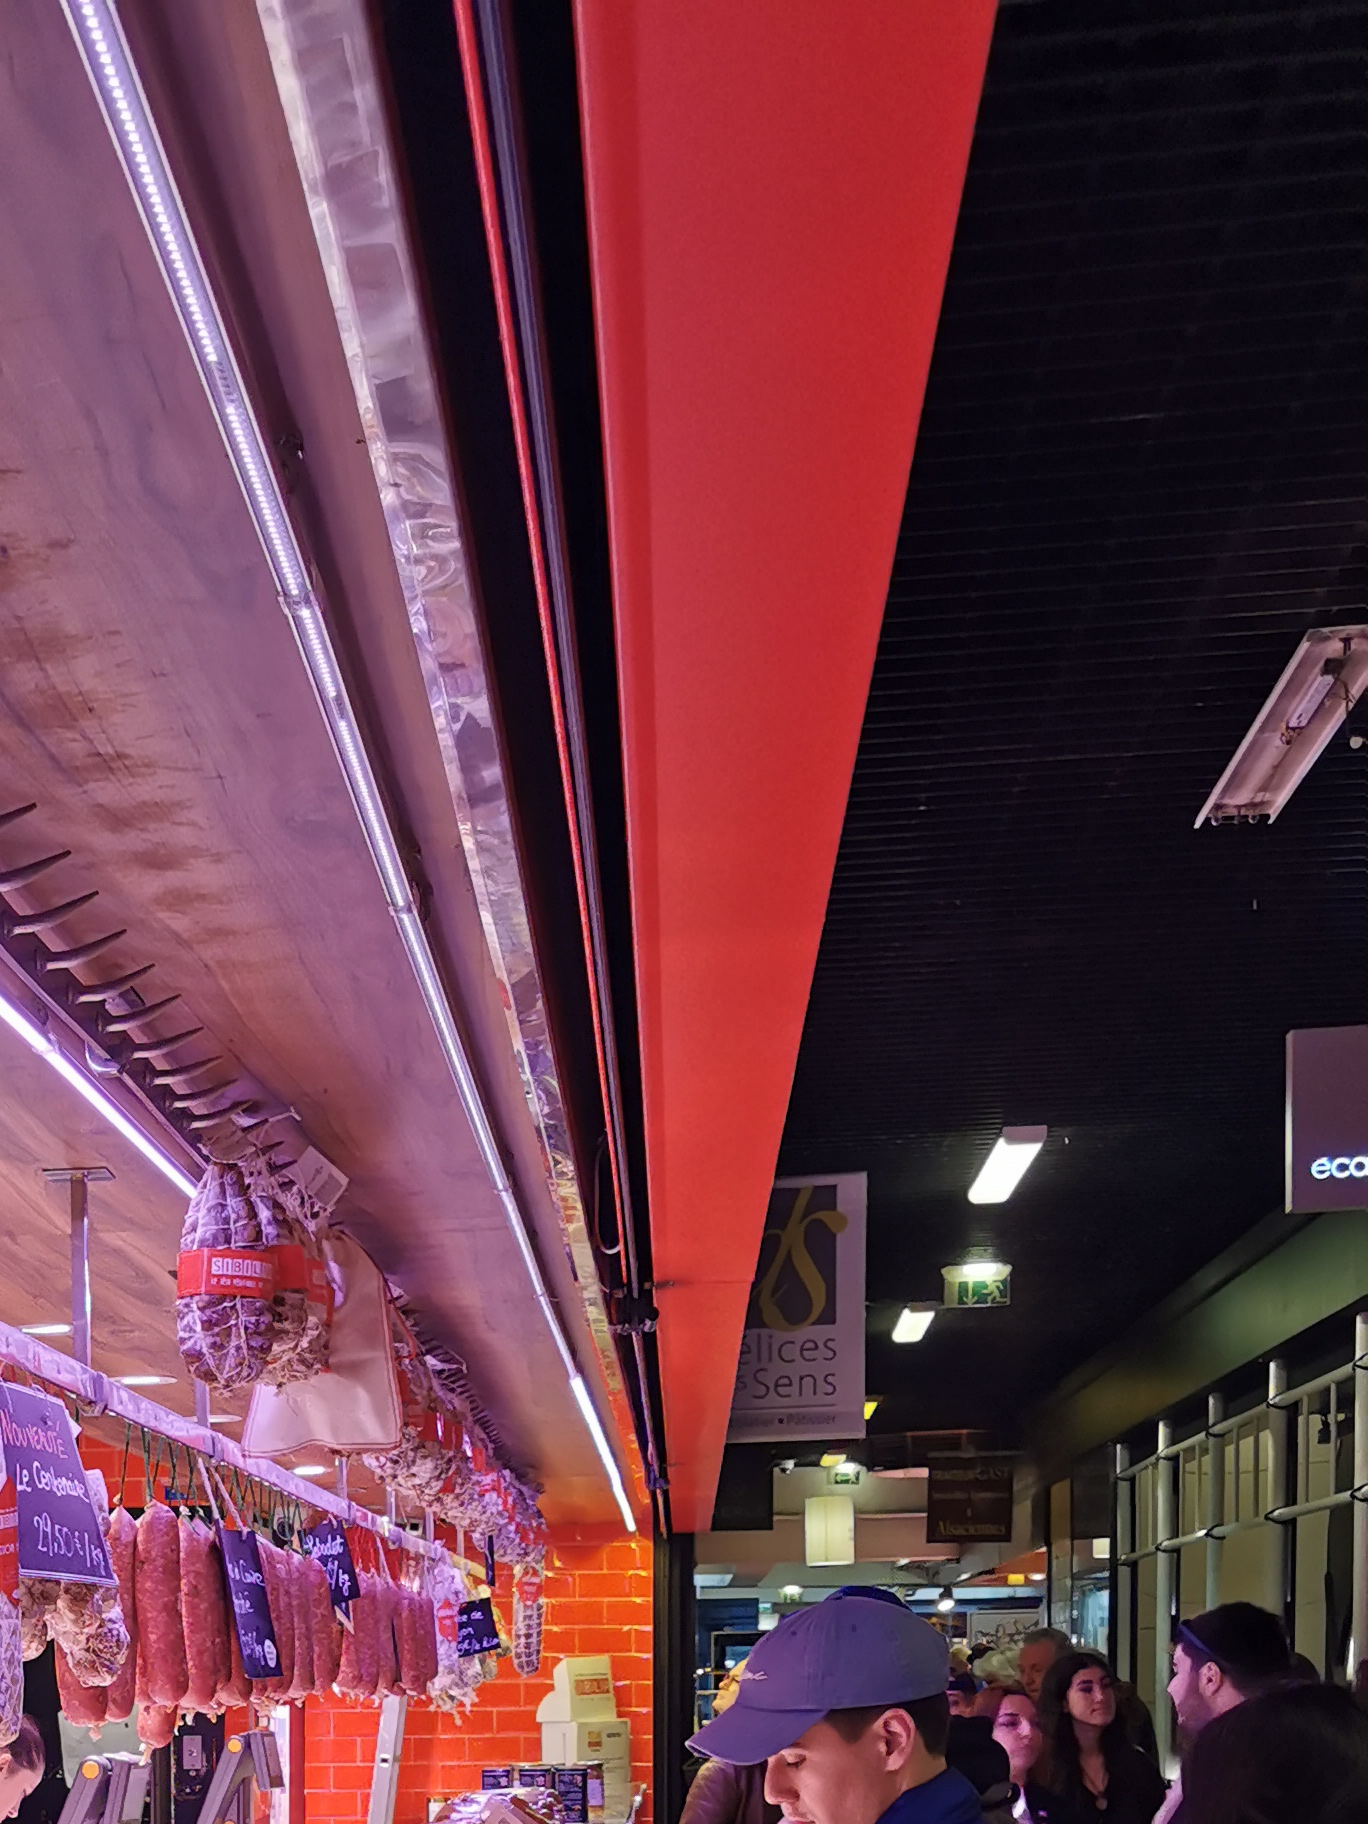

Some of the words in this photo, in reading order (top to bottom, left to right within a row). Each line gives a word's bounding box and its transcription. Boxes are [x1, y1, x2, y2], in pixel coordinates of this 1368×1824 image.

[739, 1333, 837, 1366] élices
[753, 1367, 837, 1400] Sens
[16, 1463, 32, 1493] Le
